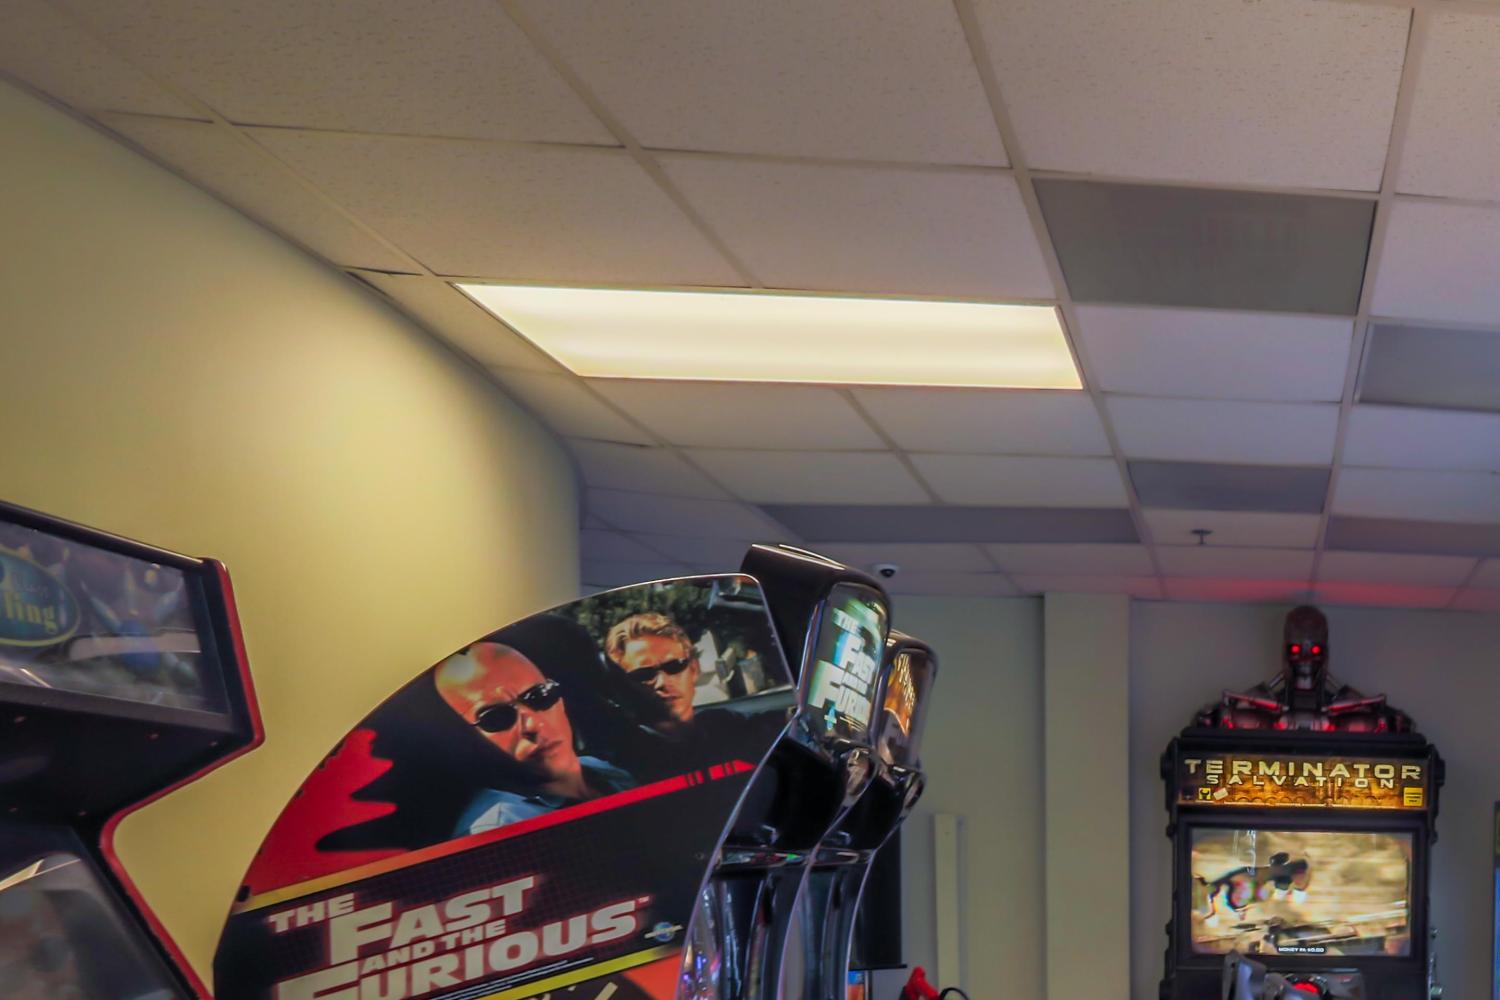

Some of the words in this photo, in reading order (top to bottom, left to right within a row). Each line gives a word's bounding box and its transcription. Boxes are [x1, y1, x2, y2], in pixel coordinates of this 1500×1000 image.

[1184, 759, 1422, 780] TERMINATOR
[1206, 774, 1394, 788] SALVATION
[268, 892, 357, 934] THE
[328, 875, 536, 966] FAST
[361, 941, 430, 973] AND
[441, 918, 508, 951] THE
